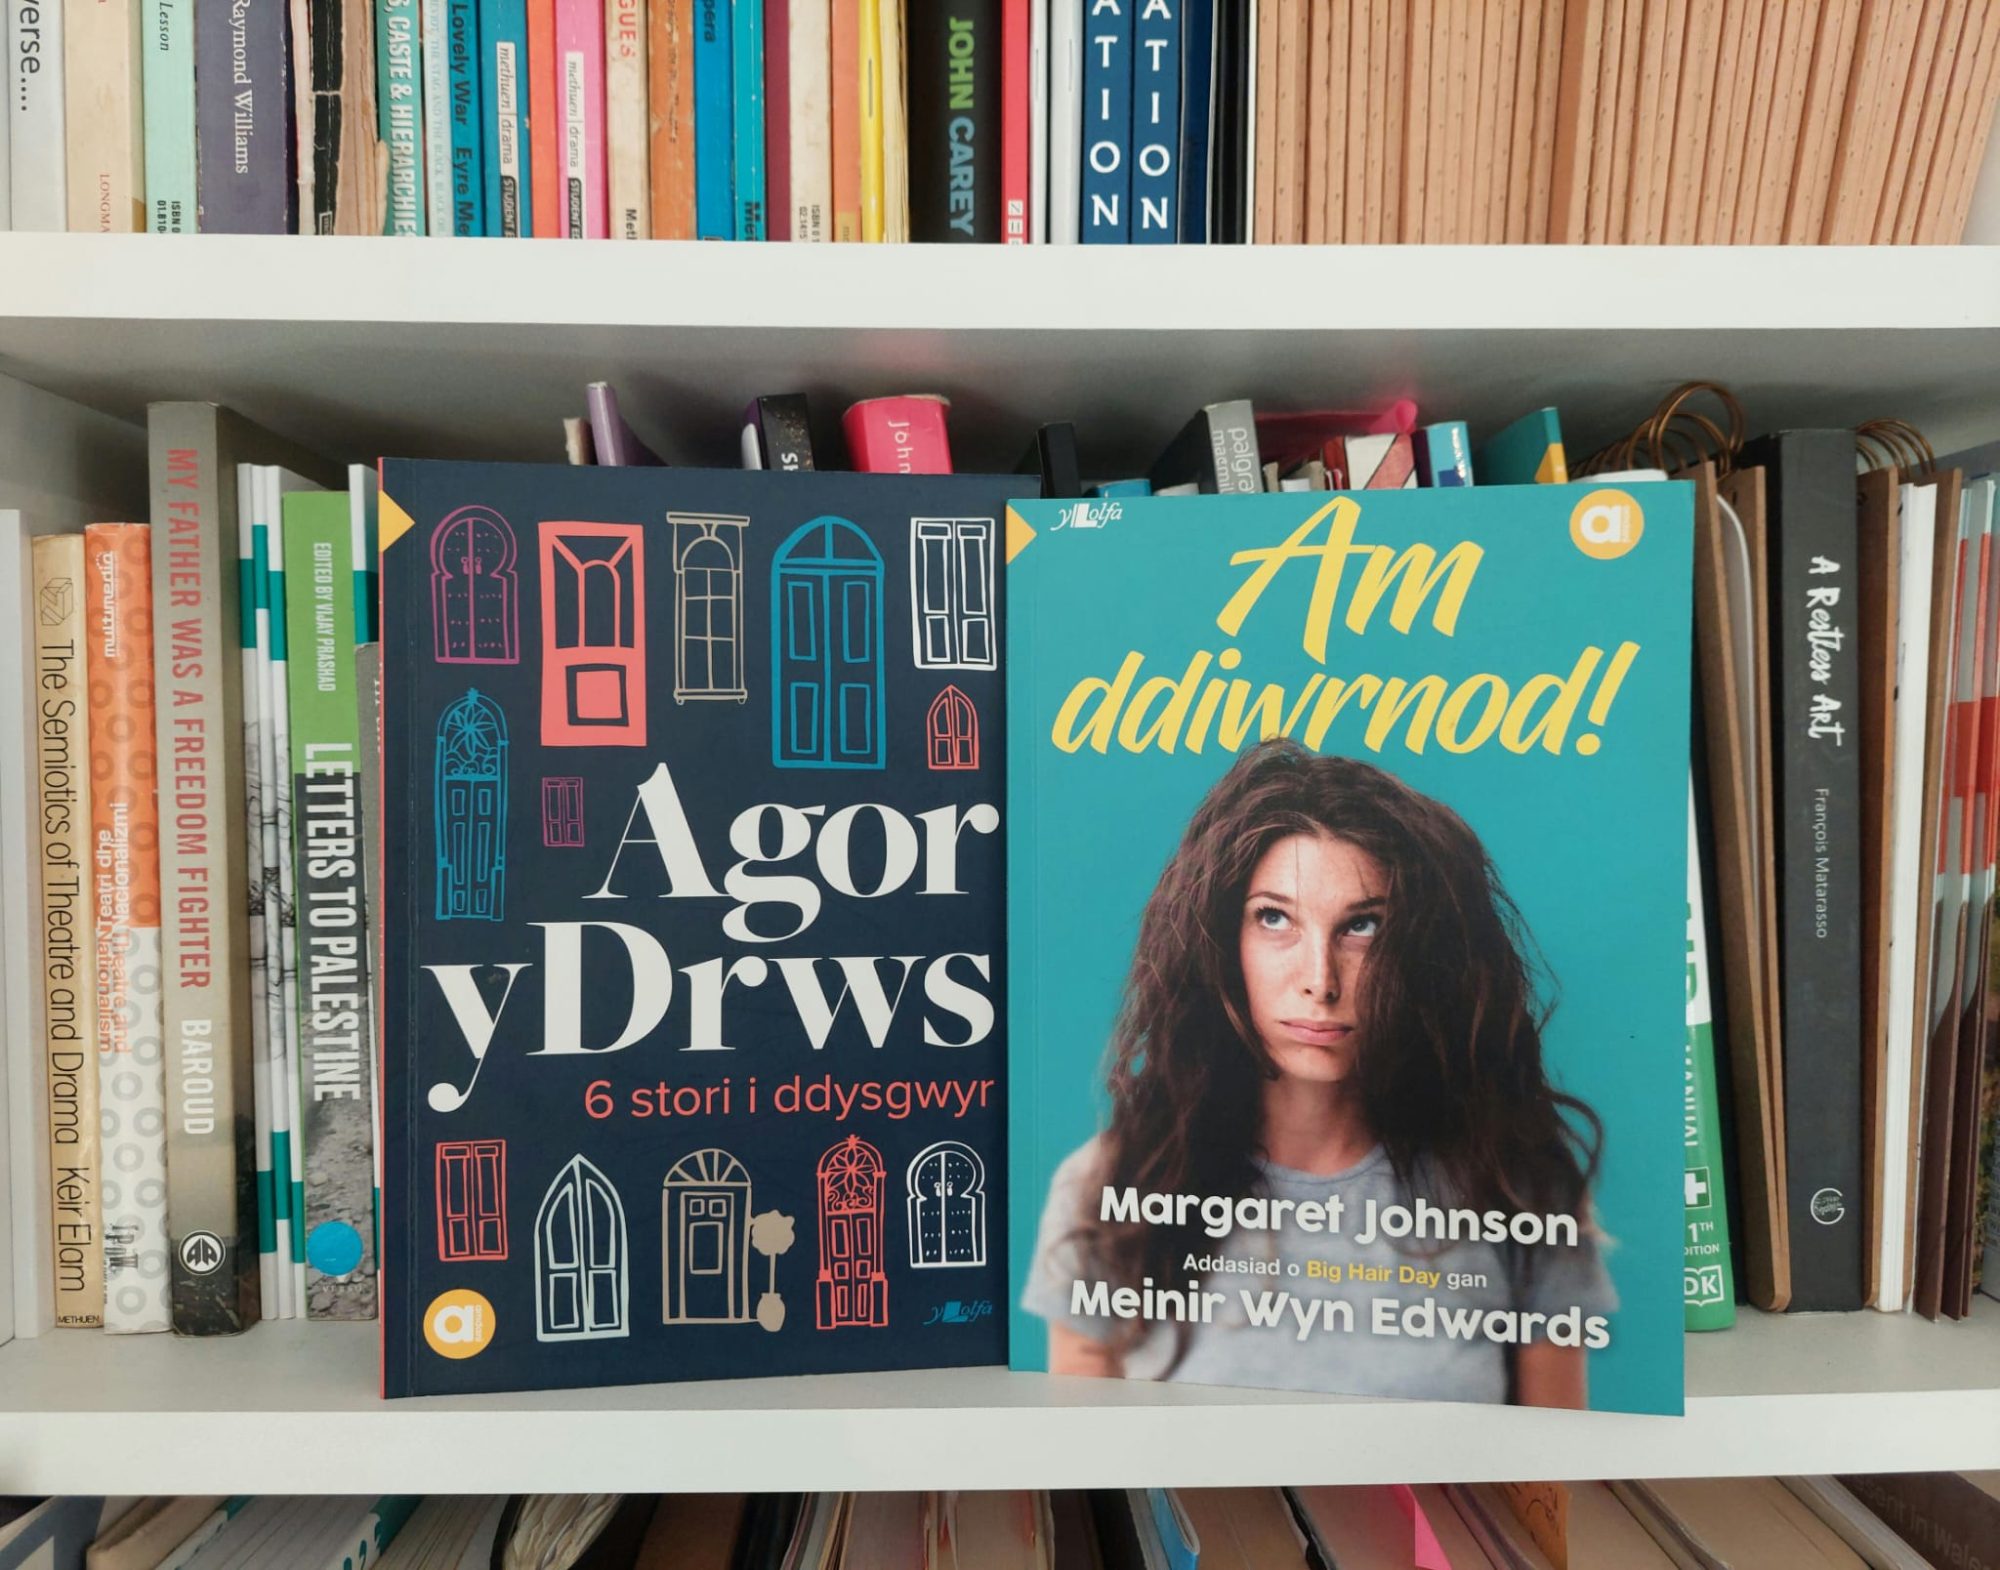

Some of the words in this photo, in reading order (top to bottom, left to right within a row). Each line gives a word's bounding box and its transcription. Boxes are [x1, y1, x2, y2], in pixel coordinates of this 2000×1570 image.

[160, 2, 173, 52] Lesson
[229, 0, 252, 84] Raymond
[388, 16, 412, 78] CASTE
[451, 3, 468, 74] Lovely
[500, 47, 514, 109] methuen
[568, 61, 579, 117] methuen
[949, 16, 975, 110] JOHN
[391, 83, 413, 100] &
[455, 81, 471, 125] War
[234, 90, 253, 174] Williams
[502, 119, 514, 164] drama
[570, 126, 581, 167] drama
[454, 147, 472, 195] Eyre
[949, 116, 976, 237] CAREY
[171, 201, 181, 225] ISBN
[504, 178, 515, 229] STUDENT
[570, 180, 581, 226] STUDENT
[167, 448, 199, 489] MY
[168, 501, 201, 606] FATHER
[313, 542, 334, 583] EDITED
[1216, 496, 1485, 665] Am
[1808, 555, 1842, 575] A
[315, 585, 335, 601] BY
[316, 602, 336, 636] VIJAY
[171, 618, 204, 679] WAS
[1806, 586, 1846, 685] Restless
[42, 638, 75, 690] The
[317, 637, 337, 691] PRASHAD
[173, 689, 204, 707] A
[1051, 641, 1640, 757] ddiwrnod!
[42, 699, 77, 834] Semiotics
[173, 718, 208, 854] FREEDOM
[305, 742, 356, 878] LETTERS
[1812, 788, 1830, 853] François
[47, 842, 80, 868] of
[96, 830, 112, 868] dhe
[582, 762, 1000, 944] Agor
[97, 874, 113, 928] Teatri
[308, 886, 358, 928] TO
[1815, 857, 1831, 938] Matarasso
[47, 876, 81, 979] Theatre
[178, 867, 211, 988] FIGHTER
[50, 988, 84, 1040] and
[97, 928, 114, 1053] Nationalism
[310, 935, 362, 1101] PALESTINE
[113, 1013, 133, 1053] and
[51, 1051, 85, 1144] Drama
[181, 1019, 215, 1135] BAROUD
[585, 1080, 614, 1119] 6
[631, 1077, 731, 1117] stori
[749, 1077, 757, 1114] i
[773, 1073, 996, 1121] ddysgwyr
[56, 1167, 91, 1218] Keir
[1100, 1185, 1345, 1238] Margaret
[1354, 1198, 1578, 1248] Johnson
[58, 1223, 92, 1291] Elam
[1183, 1253, 1281, 1277] Addasiad
[1287, 1264, 1300, 1277] o
[1307, 1260, 1342, 1283] Big
[1348, 1263, 1393, 1283] Hair
[1398, 1265, 1441, 1289] Day
[1446, 1272, 1488, 1290] gan
[58, 1316, 100, 1324] METHUEN
[1070, 1278, 1227, 1325] Meinir
[1238, 1288, 1356, 1343] Wyn
[1371, 1297, 1611, 1350] Edwards
